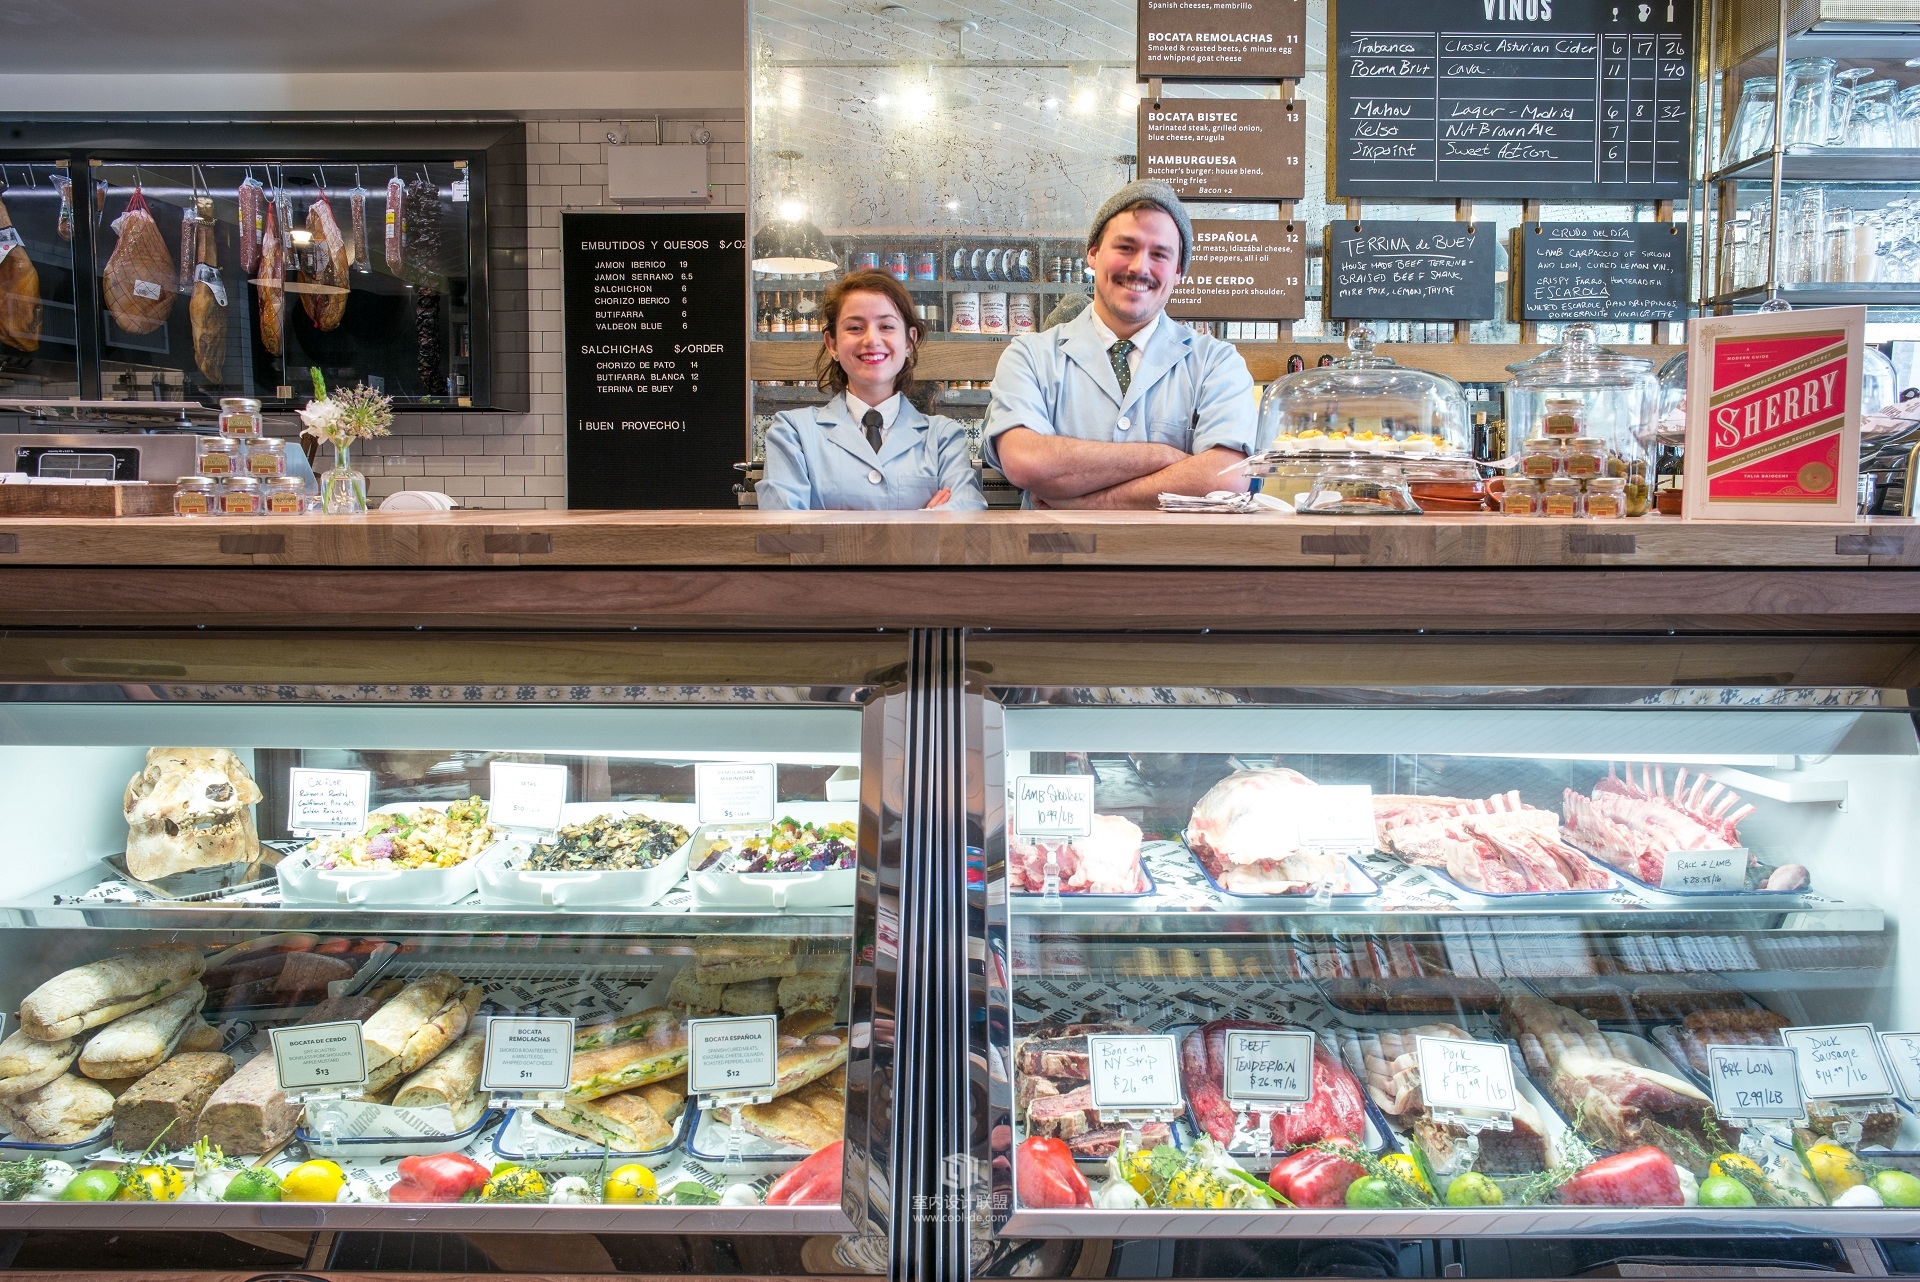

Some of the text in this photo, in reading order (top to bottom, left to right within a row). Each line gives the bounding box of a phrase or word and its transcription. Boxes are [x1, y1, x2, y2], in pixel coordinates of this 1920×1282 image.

[1149, 33, 1298, 43] BOCATA REMOLACHAS 11
[1218, 45, 1241, 53] beets,
[1353, 38, 1684, 55] Trabanco Classic Asturian Cider 6 17 26
[1197, 55, 1214, 63] goat
[1400, 61, 1685, 77] Brut 11 40
[1355, 101, 1411, 116] Mahou
[1608, 105, 1618, 117] 6
[1636, 105, 1643, 116] 8
[1661, 106, 1686, 118] 32
[1149, 113, 1194, 121] BOCATA
[1198, 113, 1237, 121] BISTEC
[1212, 125, 1236, 133] grilled
[1355, 120, 1398, 136] Kelso
[1608, 127, 1619, 138] 7
[1353, 142, 1416, 163] Sixpoint
[1446, 142, 1491, 156] Sweet
[1608, 146, 1618, 158] 6
[1149, 156, 1298, 165] HAMBURGUESA 13
[1186, 168, 1214, 176] burger:
[1198, 232, 1298, 242] ESPAÑOLA 12
[1552, 228, 1587, 238] CRUDO
[1593, 230, 1608, 238] DEL
[582, 241, 645, 250] EMBUTIDOS
[651, 241, 658, 249] Y
[664, 241, 709, 249] QUESOS
[1340, 235, 1475, 257] TERRINA de BUEY
[631, 273, 673, 281] SERRANO
[1216, 277, 1254, 285] CERDO
[1286, 277, 1298, 285] 13
[1232, 288, 1249, 296] pork
[1534, 287, 1609, 300] ESCAROLA
[582, 345, 723, 354] SALCHICHAS $/ORDER
[1715, 370, 1839, 450] SHERRY
[1022, 783, 1045, 803] LAMB
[1709, 859, 1731, 868] LAMB
[1240, 1038, 1270, 1054] BEEF
[1806, 1036, 1841, 1049] Duck
[1105, 1056, 1157, 1069] NY Strip
[1812, 1049, 1858, 1066] Sausage
